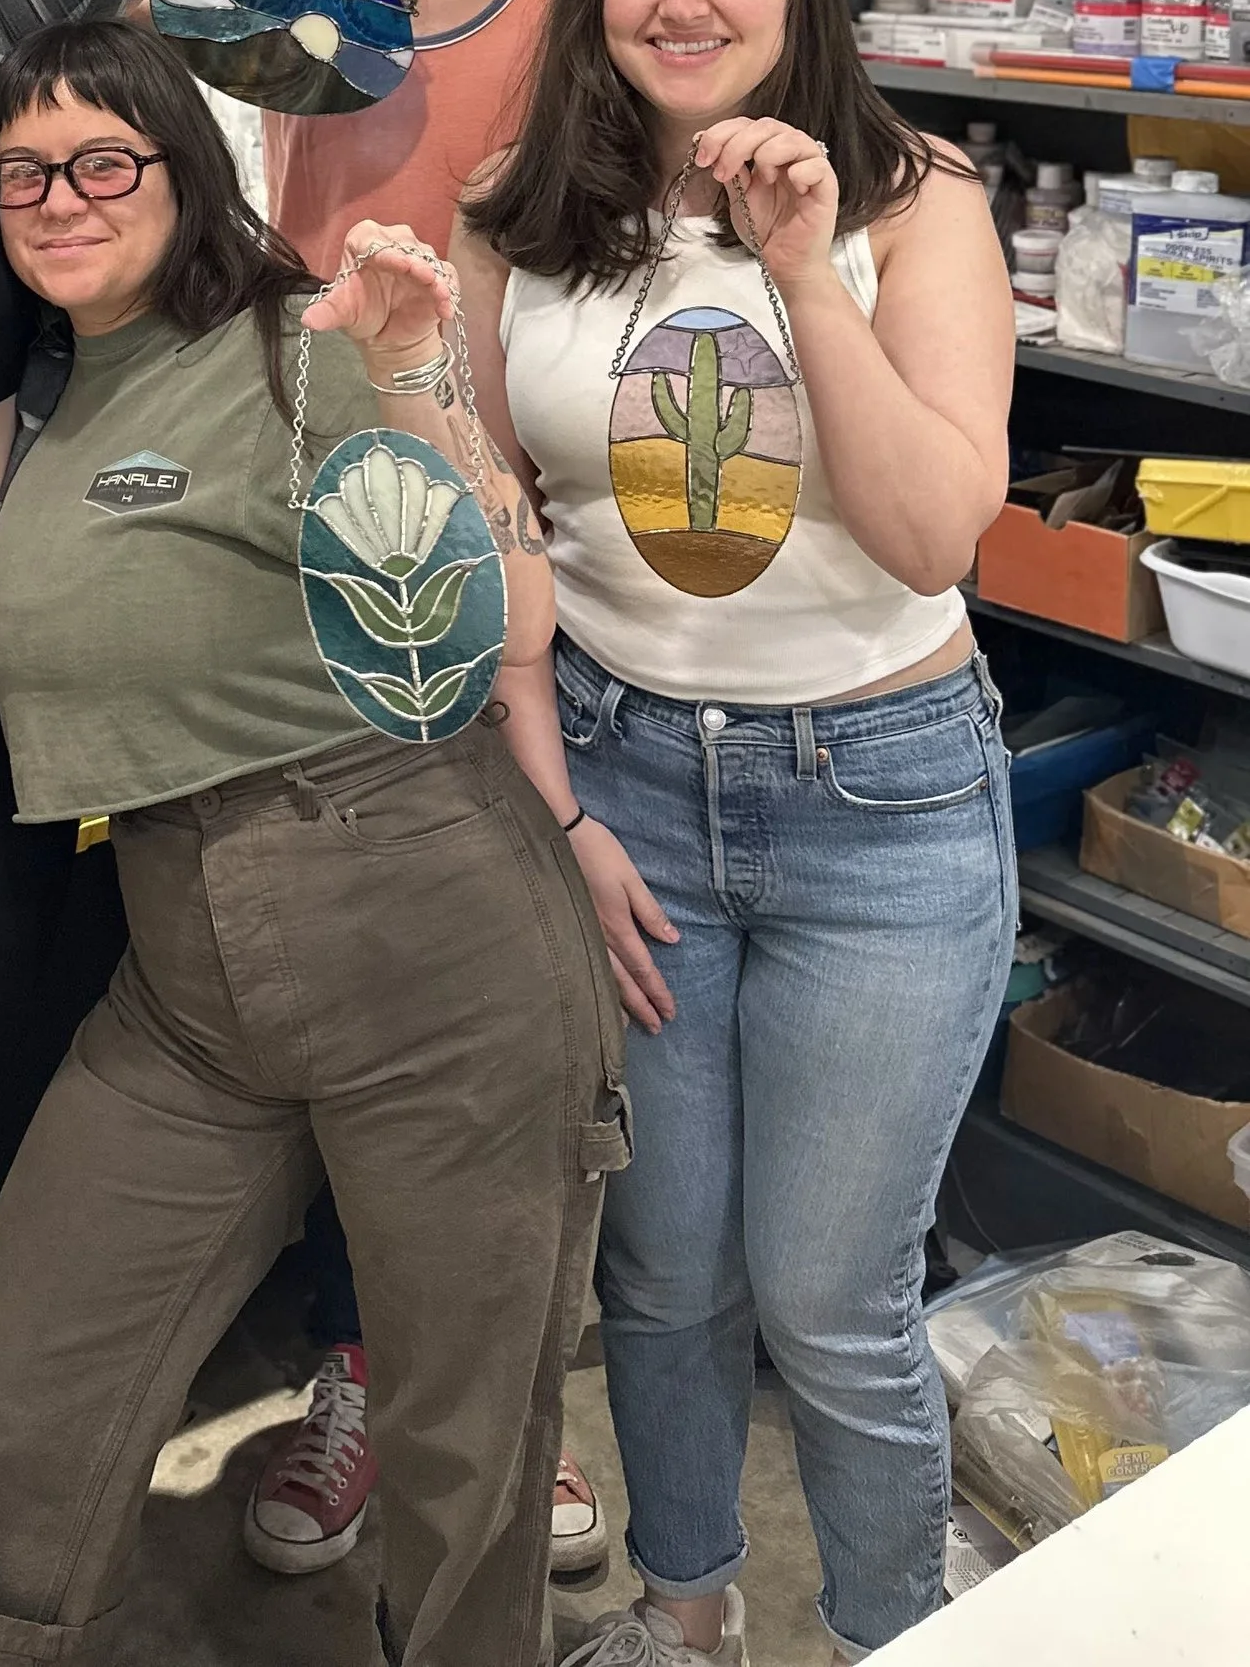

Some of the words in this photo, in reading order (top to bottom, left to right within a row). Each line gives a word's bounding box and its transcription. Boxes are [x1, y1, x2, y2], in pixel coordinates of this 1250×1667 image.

[1165, 242, 1213, 255] ODORLESS
[1191, 252, 1234, 267] SPIRITS
[96, 472, 178, 489] HANALEI
[120, 494, 134, 503] HI
[1115, 1451, 1151, 1464] TEMP
[1107, 1463, 1158, 1477] CONTRO
